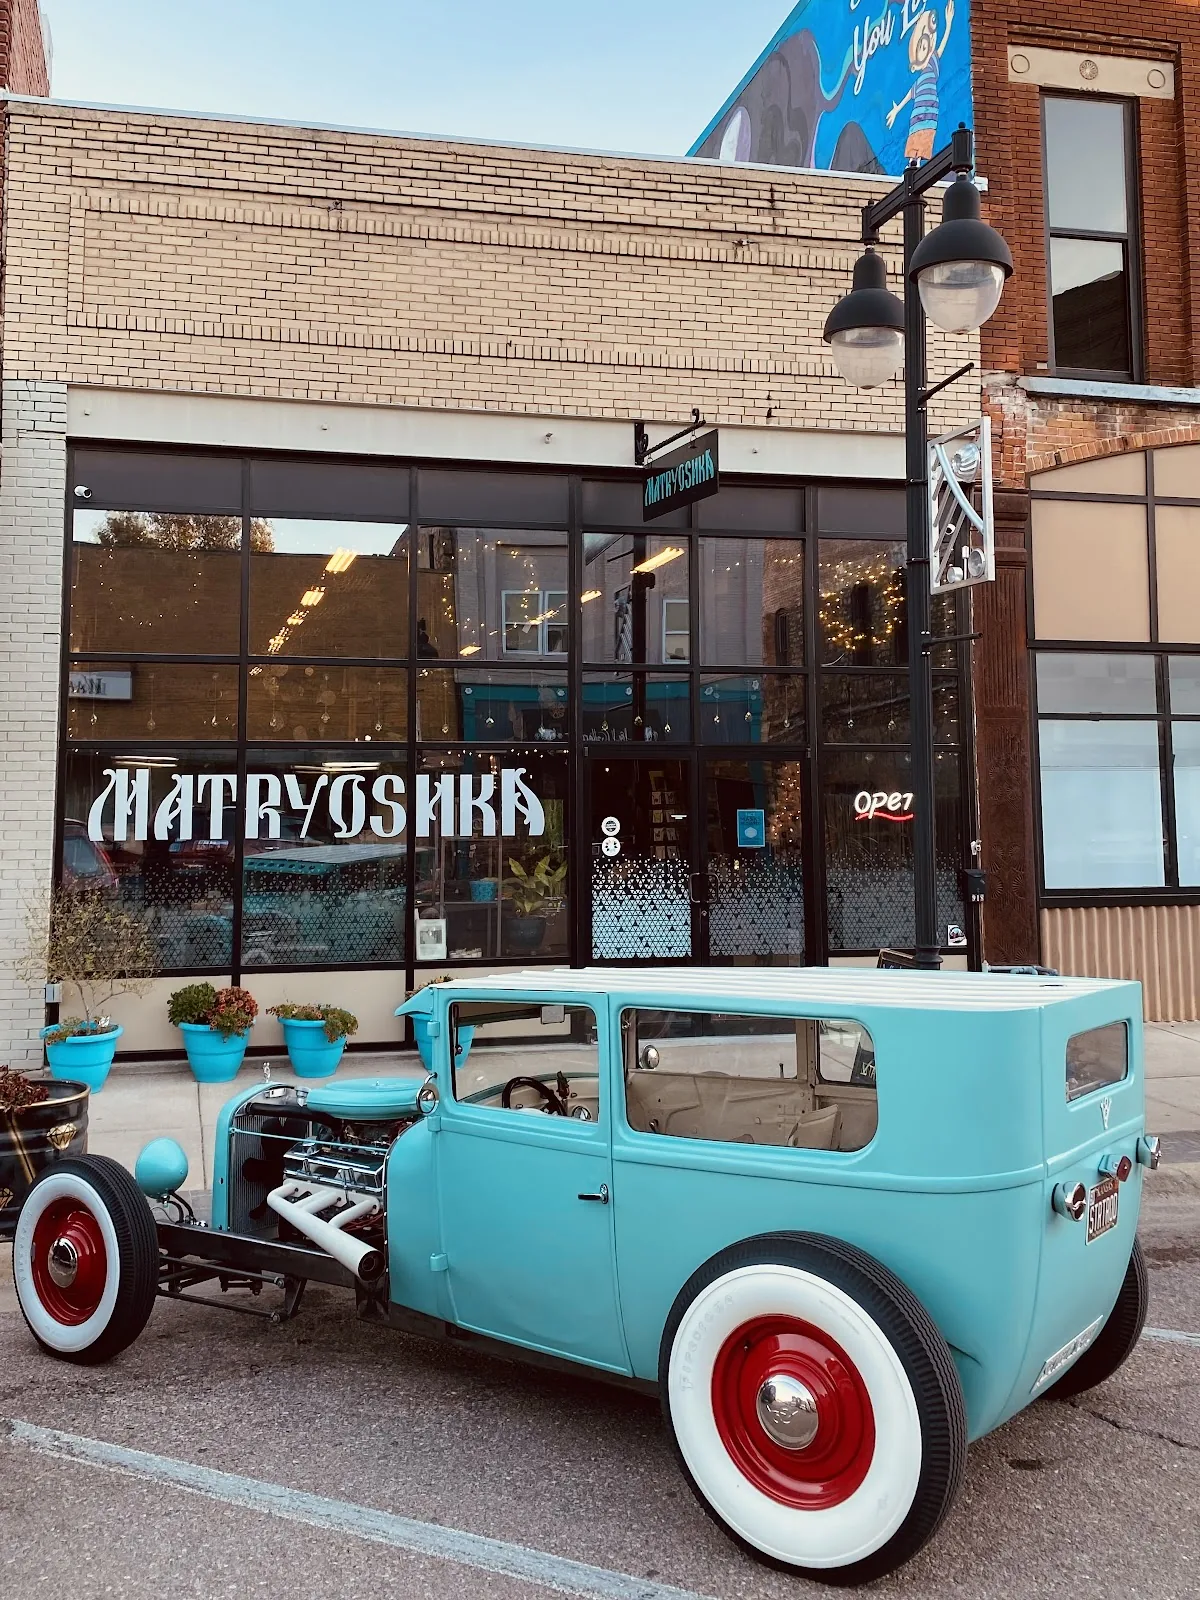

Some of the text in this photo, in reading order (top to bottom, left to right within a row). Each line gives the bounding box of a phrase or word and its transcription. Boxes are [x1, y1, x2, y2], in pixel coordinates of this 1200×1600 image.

[853, 9, 896, 96] You
[644, 448, 715, 507] MATRYOSHKA
[87, 767, 546, 842] MATRYOSHKA
